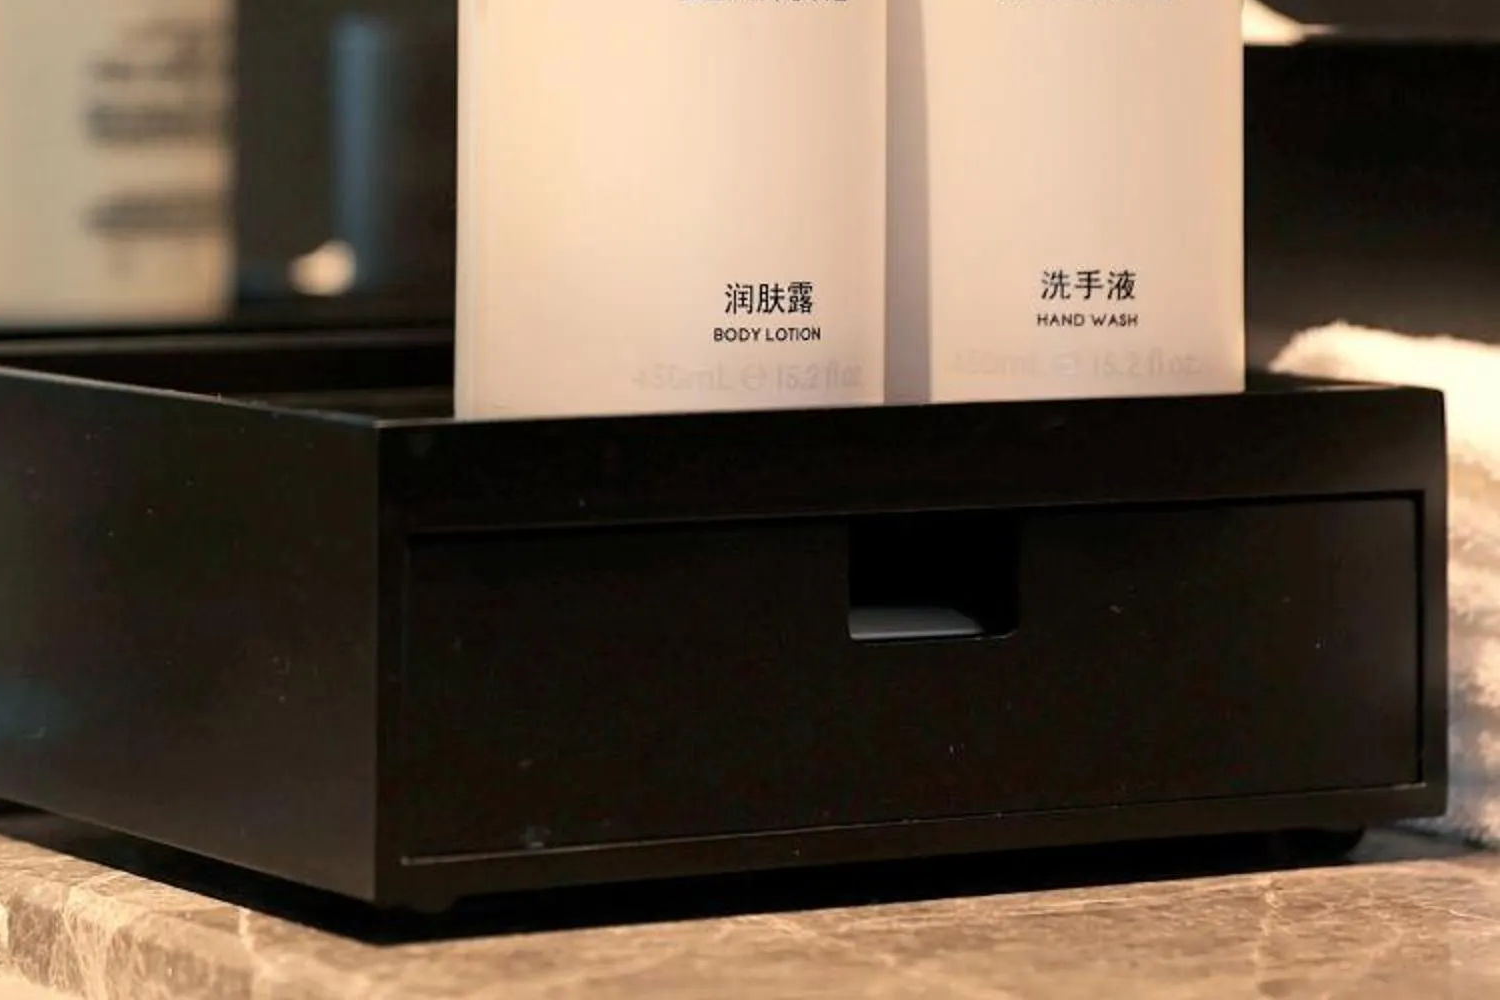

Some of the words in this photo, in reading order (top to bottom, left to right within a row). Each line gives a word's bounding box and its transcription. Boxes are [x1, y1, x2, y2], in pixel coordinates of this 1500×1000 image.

[1040, 269, 1138, 300] 洗手液
[724, 280, 814, 315] 润肤露
[1036, 313, 1086, 327] HAND
[1090, 313, 1139, 327] WASH
[713, 327, 761, 342] BODY
[765, 327, 822, 342] LOTION
